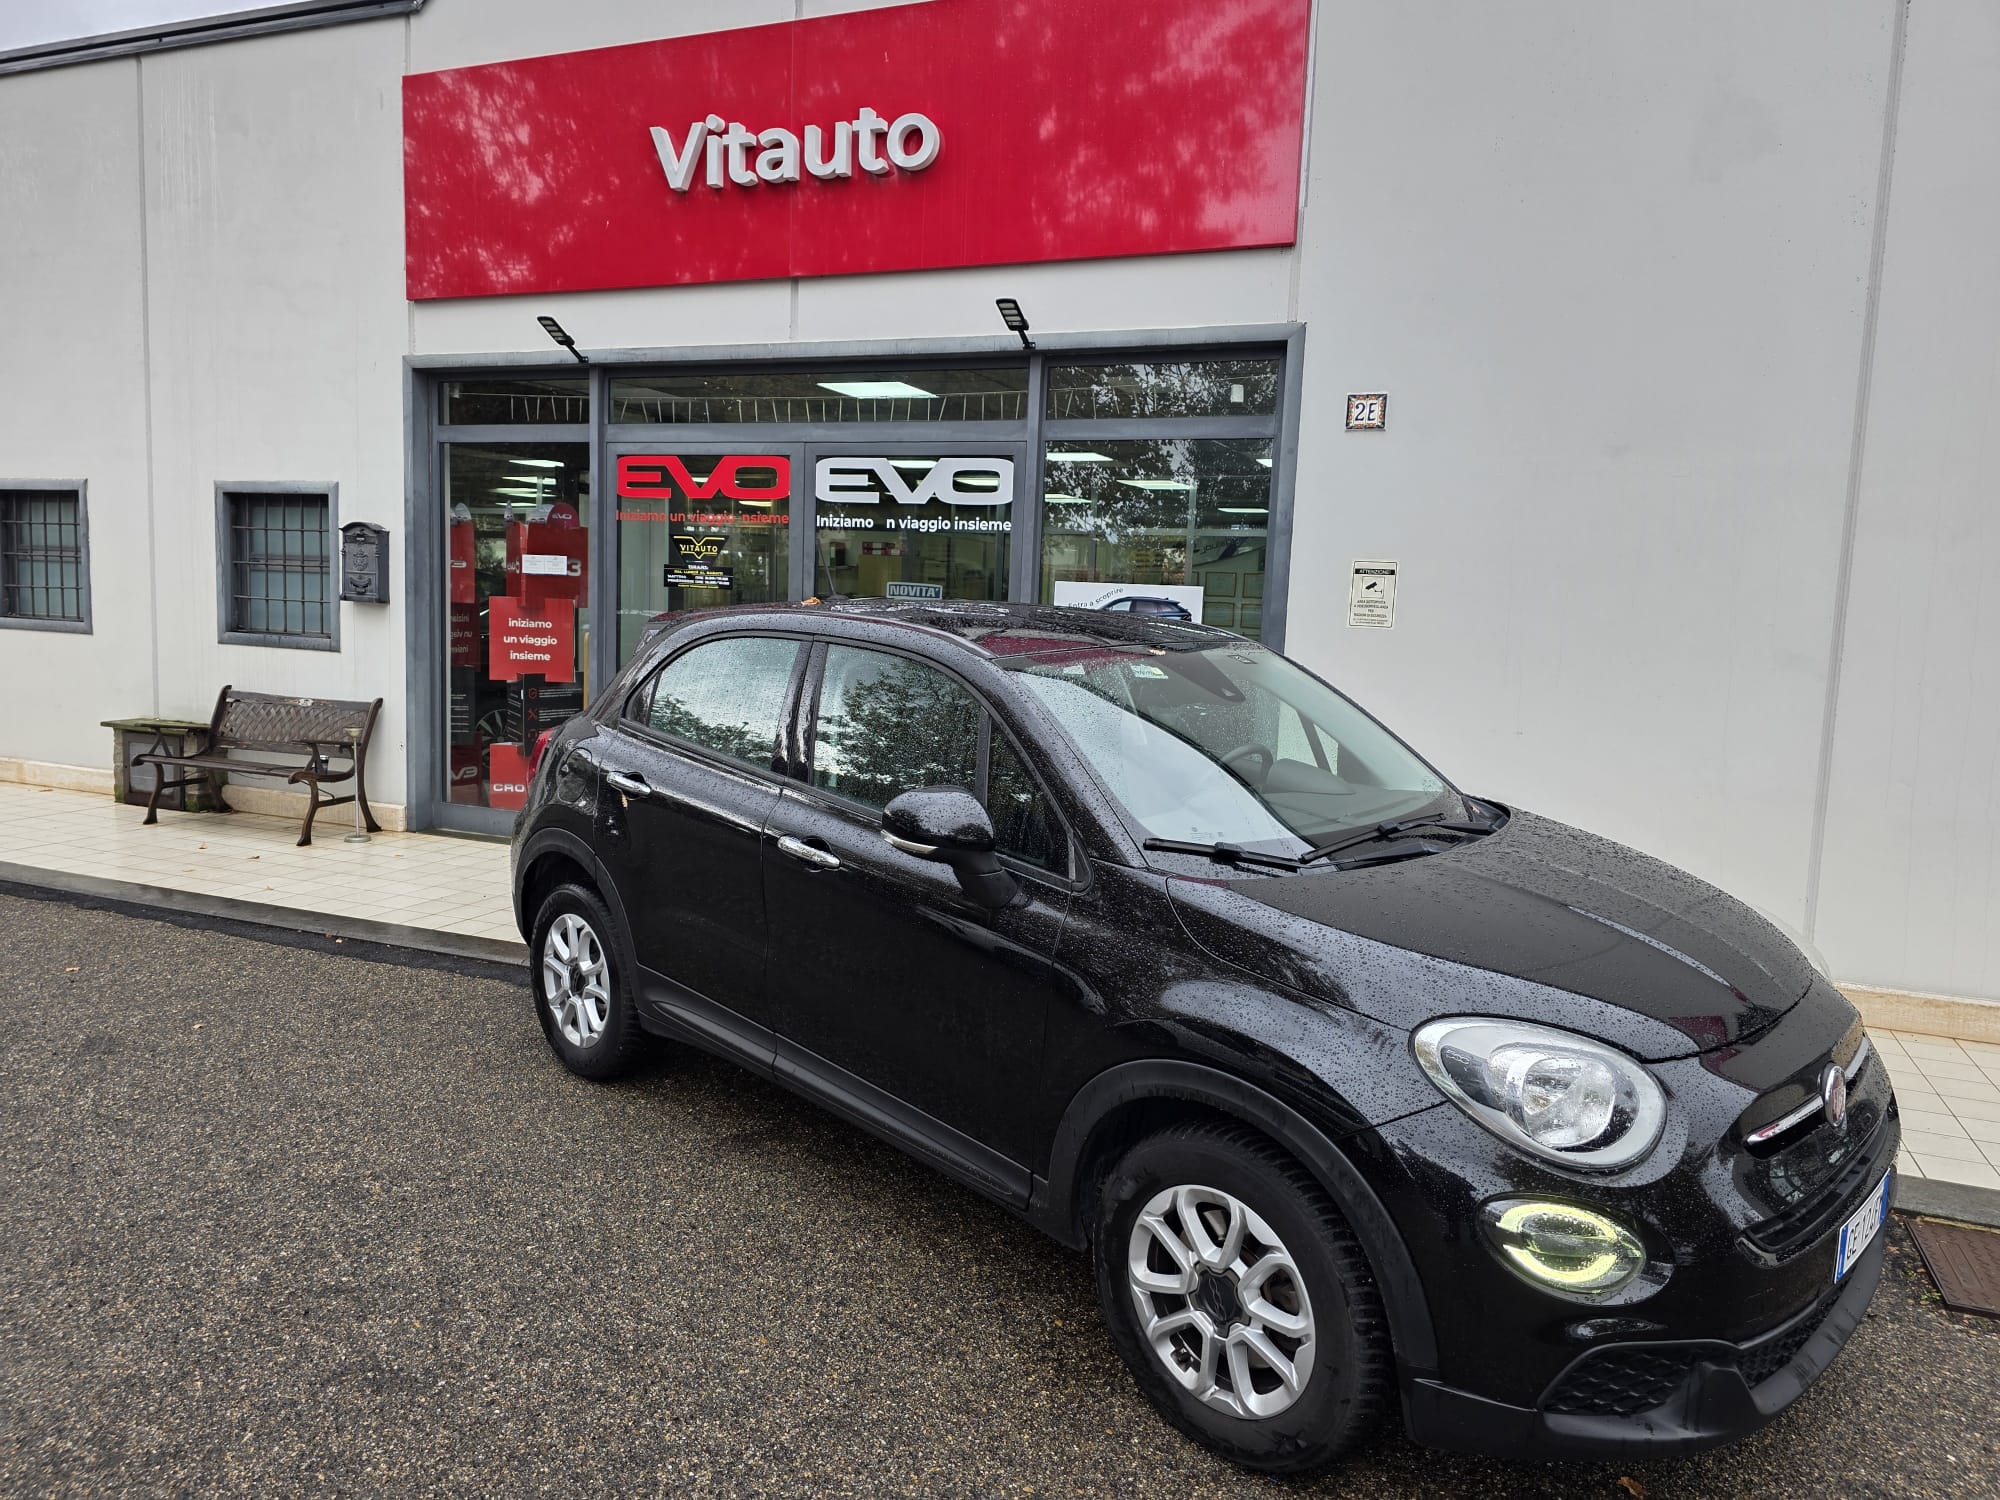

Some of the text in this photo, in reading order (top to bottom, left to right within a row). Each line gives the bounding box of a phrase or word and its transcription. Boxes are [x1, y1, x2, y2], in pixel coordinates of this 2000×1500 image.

[650, 107, 940, 192] Vitauto
[1355, 402, 1378, 421] 2E
[617, 455, 791, 500] EVO
[816, 457, 1014, 505] EVO
[616, 509, 790, 526] Iniziamo un viaggio nsieme
[816, 514, 874, 529] Iniziamo
[899, 516, 951, 533] viaggio
[954, 517, 1012, 532] insieme
[680, 544, 718, 553] VITAUTO
[508, 617, 553, 629] iniziamo
[503, 635, 558, 647] un viaggio
[510, 650, 551, 661] insieme
